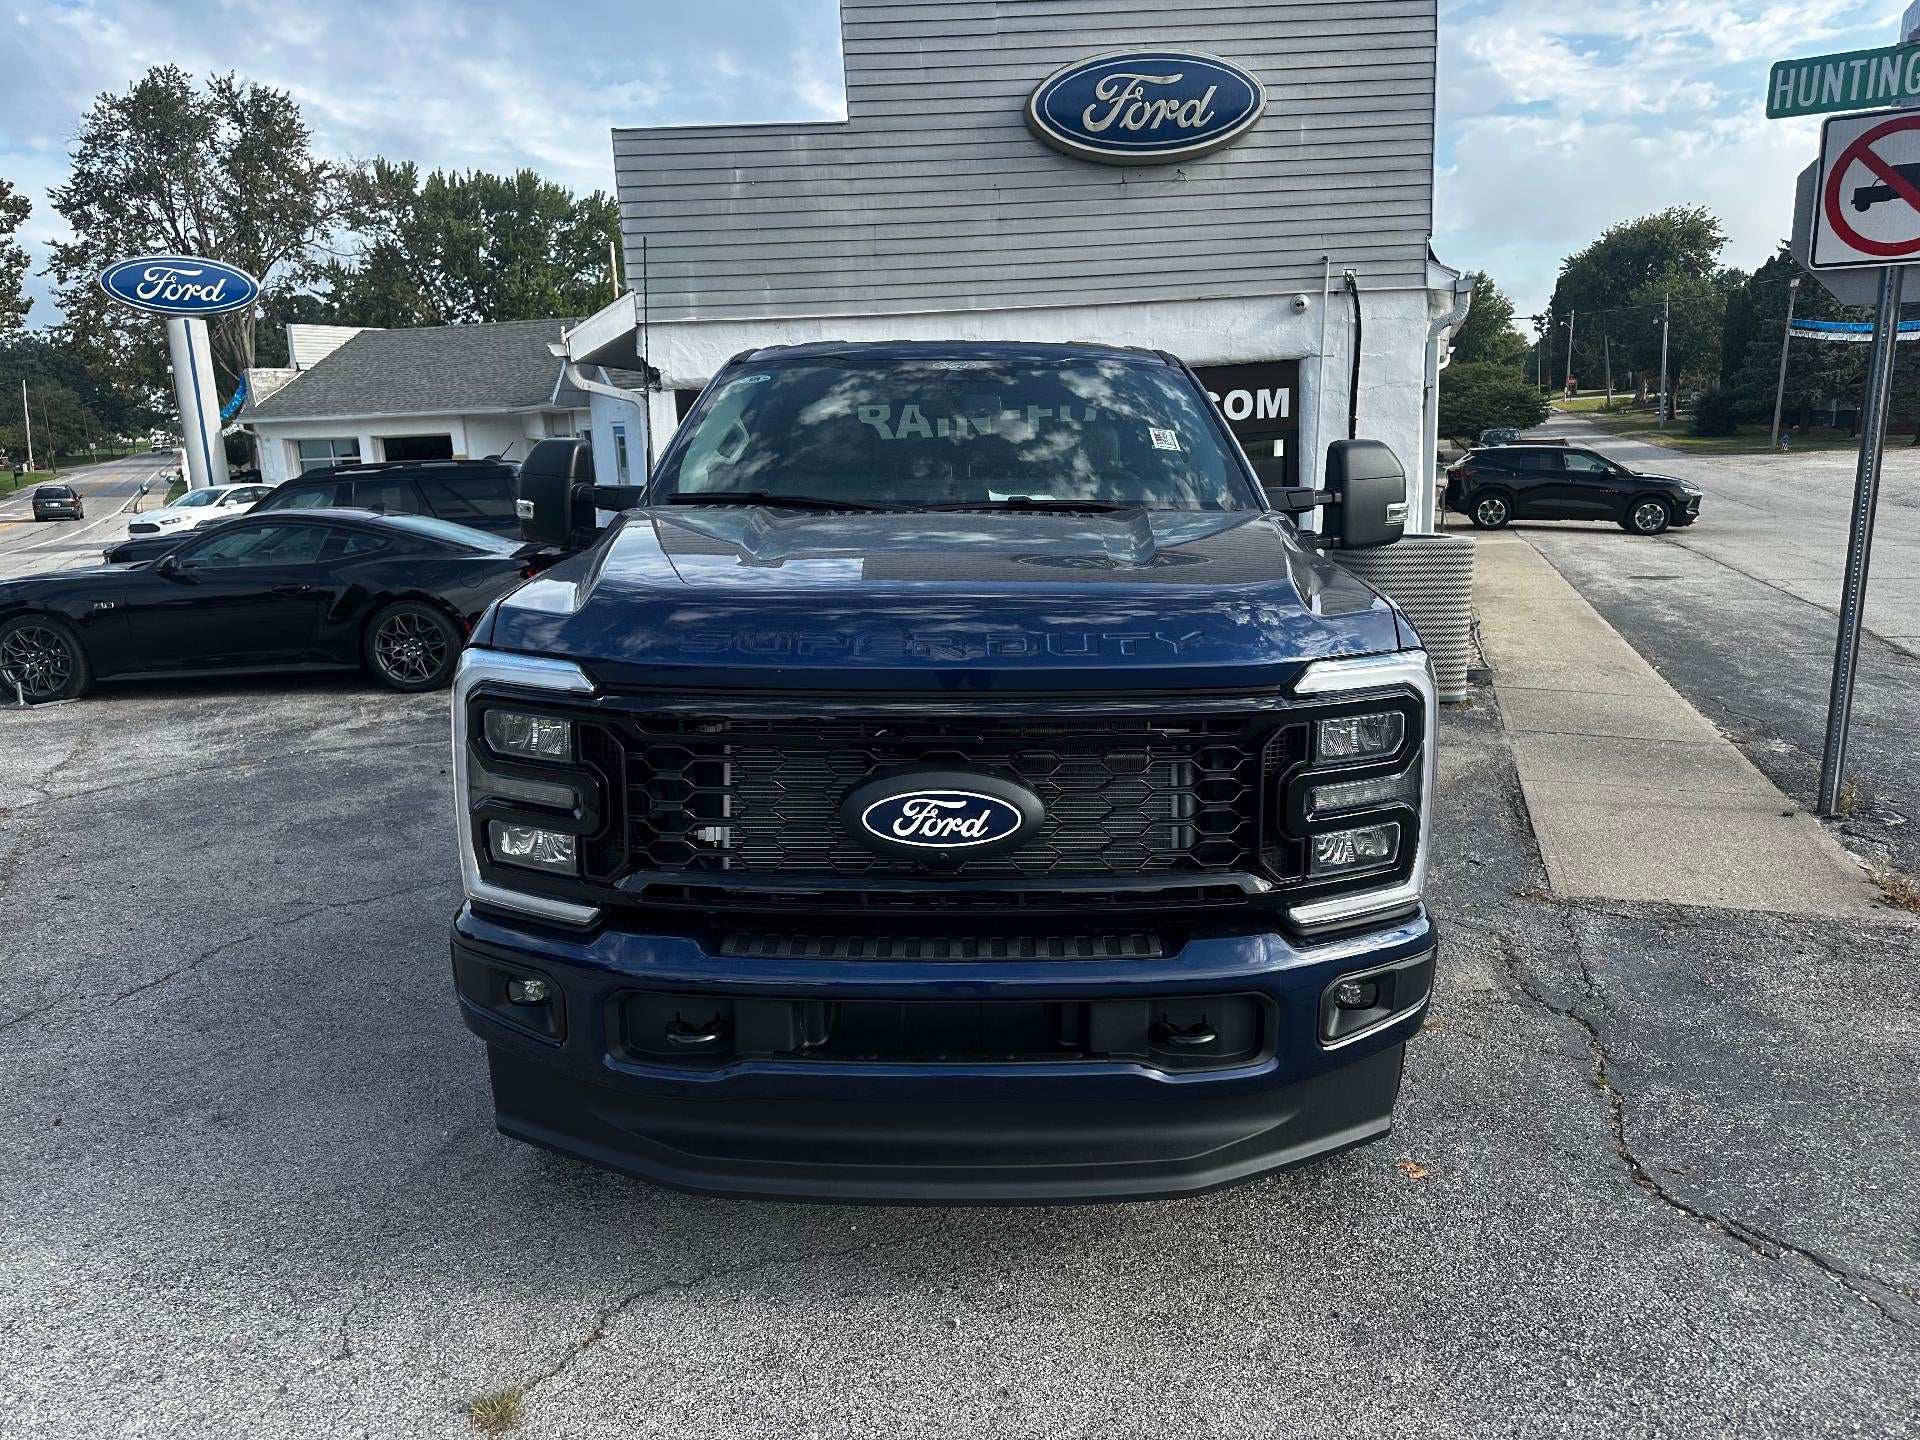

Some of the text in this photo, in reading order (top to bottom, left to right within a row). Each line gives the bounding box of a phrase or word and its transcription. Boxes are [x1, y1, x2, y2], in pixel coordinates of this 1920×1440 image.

[1772, 51, 1920, 110] HUNTING
[1082, 73, 1218, 132] Ford
[136, 266, 227, 302] Ford
[1207, 387, 1290, 421] OM
[679, 630, 1206, 660] SUPER DUTY
[892, 798, 991, 838] Ford
